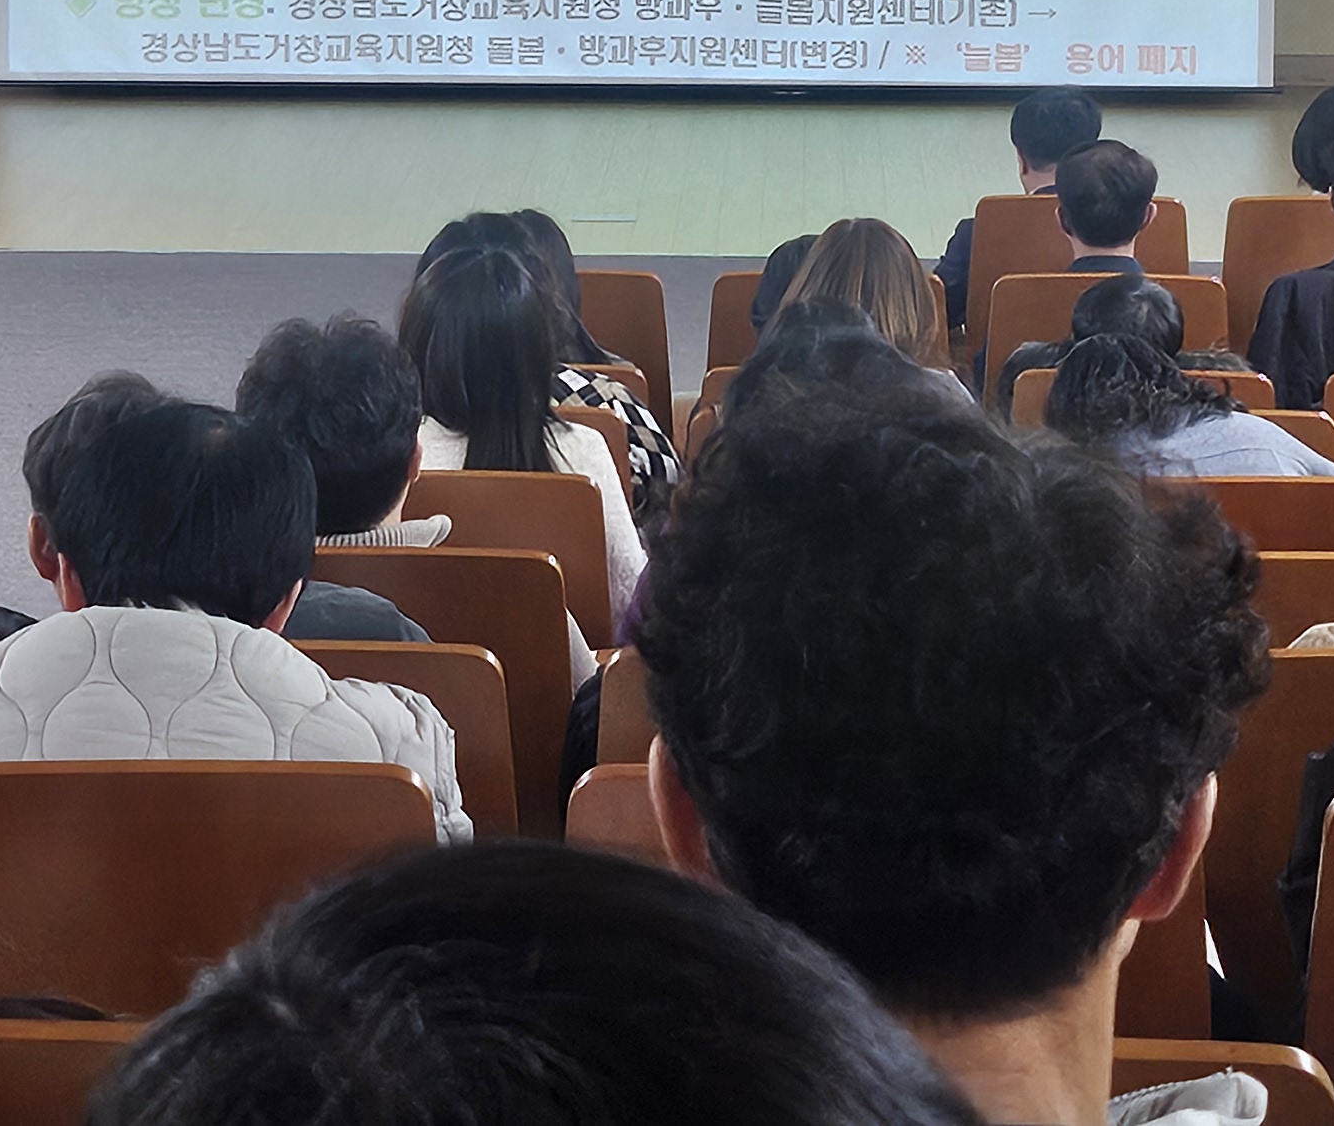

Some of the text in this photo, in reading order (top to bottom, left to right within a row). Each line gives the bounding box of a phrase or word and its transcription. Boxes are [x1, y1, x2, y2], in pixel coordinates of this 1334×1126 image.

[141, 33, 474, 65] 경상남도거창교육지원청
[487, 36, 545, 66] 돌봄
[1066, 43, 1125, 75] 용어
[1137, 45, 1198, 76] 폐지
